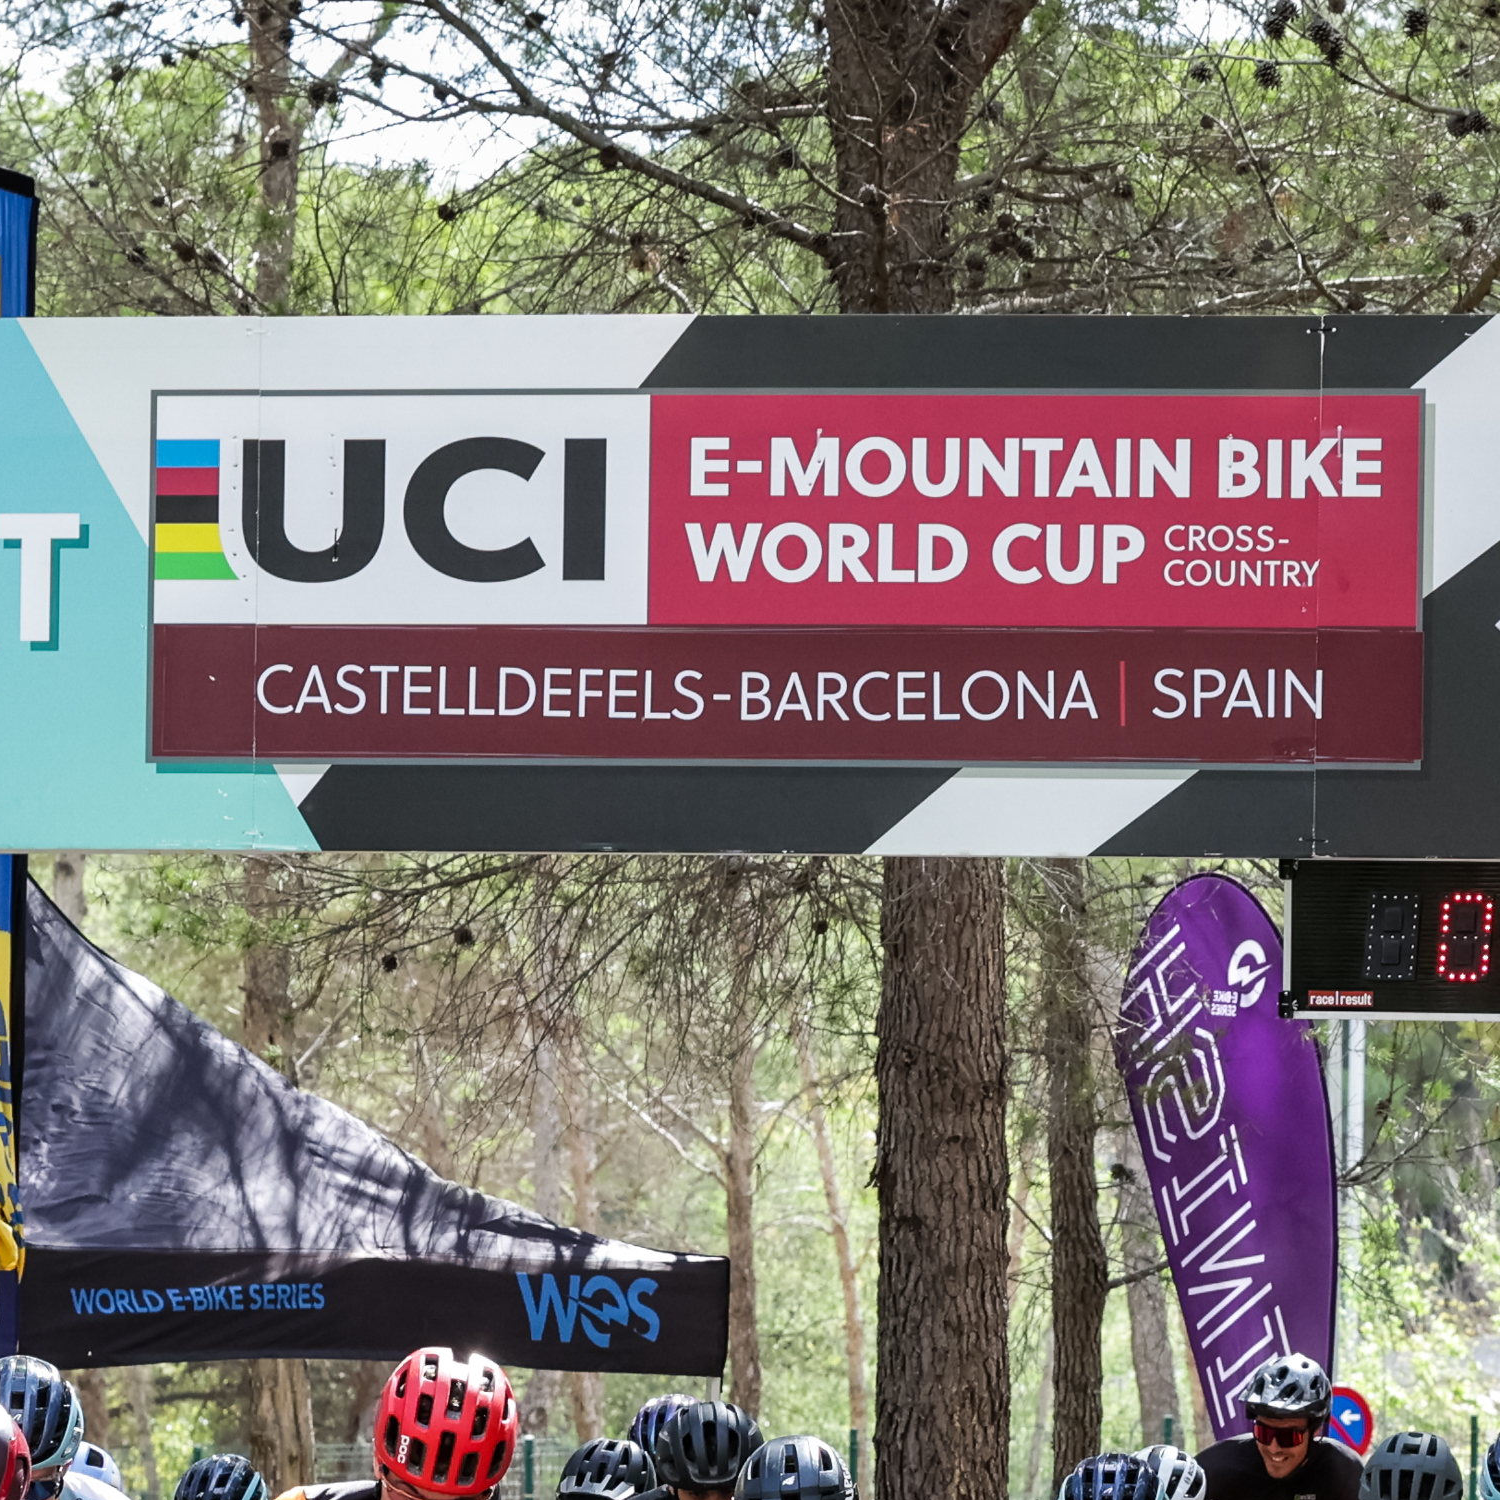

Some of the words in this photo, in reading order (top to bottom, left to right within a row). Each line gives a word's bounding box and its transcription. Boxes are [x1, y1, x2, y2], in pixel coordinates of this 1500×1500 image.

[689, 435, 1186, 499] E-MOUNTAIN
[1226, 437, 1383, 500] BIKE
[242, 437, 607, 583] UCI
[1164, 524, 1290, 553] CROSS-
[685, 522, 978, 584] WORLD
[992, 523, 1146, 585] CUP
[1164, 559, 1320, 588] COUNTRY
[256, 664, 1100, 722] CASTELLDEFELS-BARCELONA
[1151, 667, 1325, 720] SPAIN
[71, 1287, 164, 1316] WORLD
[171, 1285, 244, 1313] E-BIKE
[249, 1283, 326, 1310] SERIES
